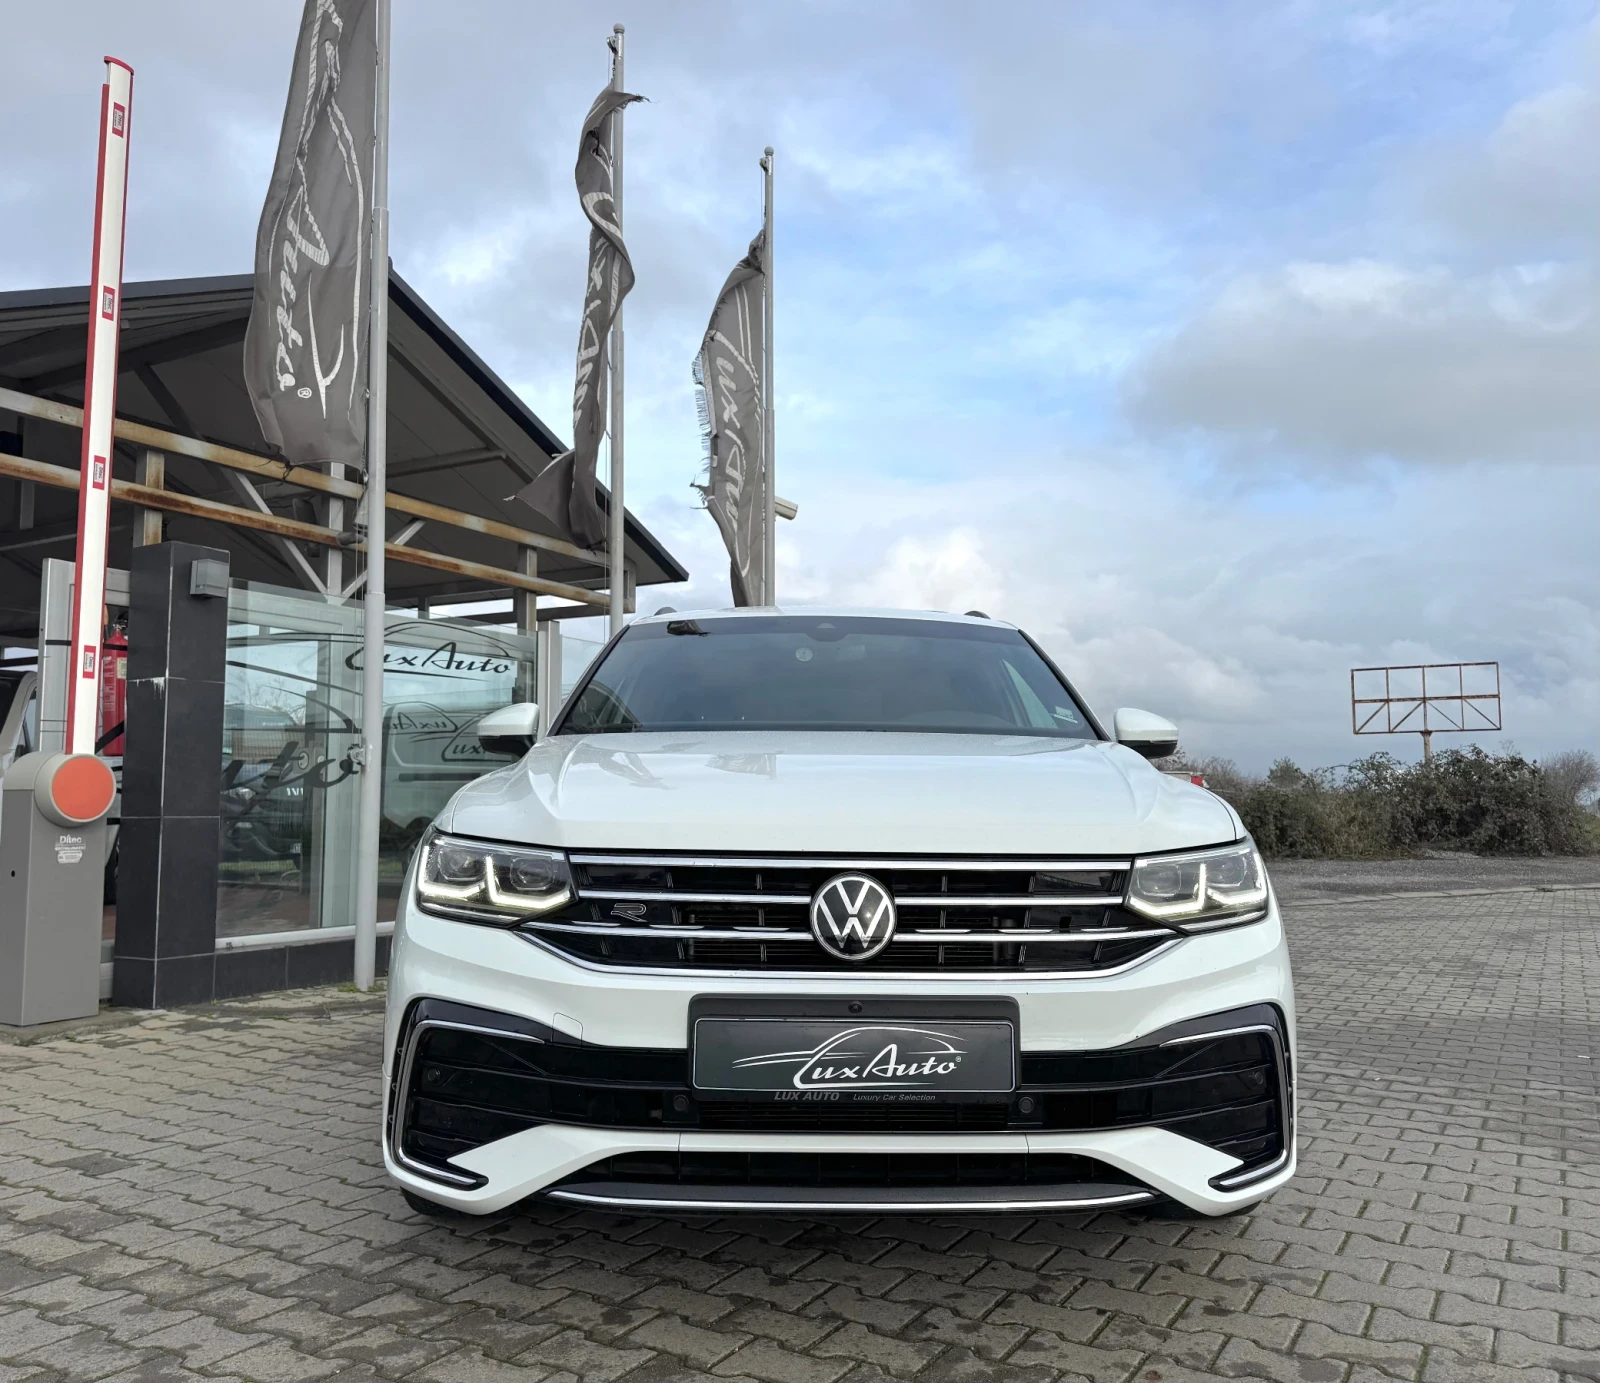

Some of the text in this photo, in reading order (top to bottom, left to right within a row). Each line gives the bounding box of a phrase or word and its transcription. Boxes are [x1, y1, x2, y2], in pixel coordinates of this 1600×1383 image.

[773, 1091, 801, 1101] LUX
[802, 1091, 840, 1101] AUTO
[853, 1093, 881, 1102] Luxury
[898, 1093, 936, 1101] Selection
